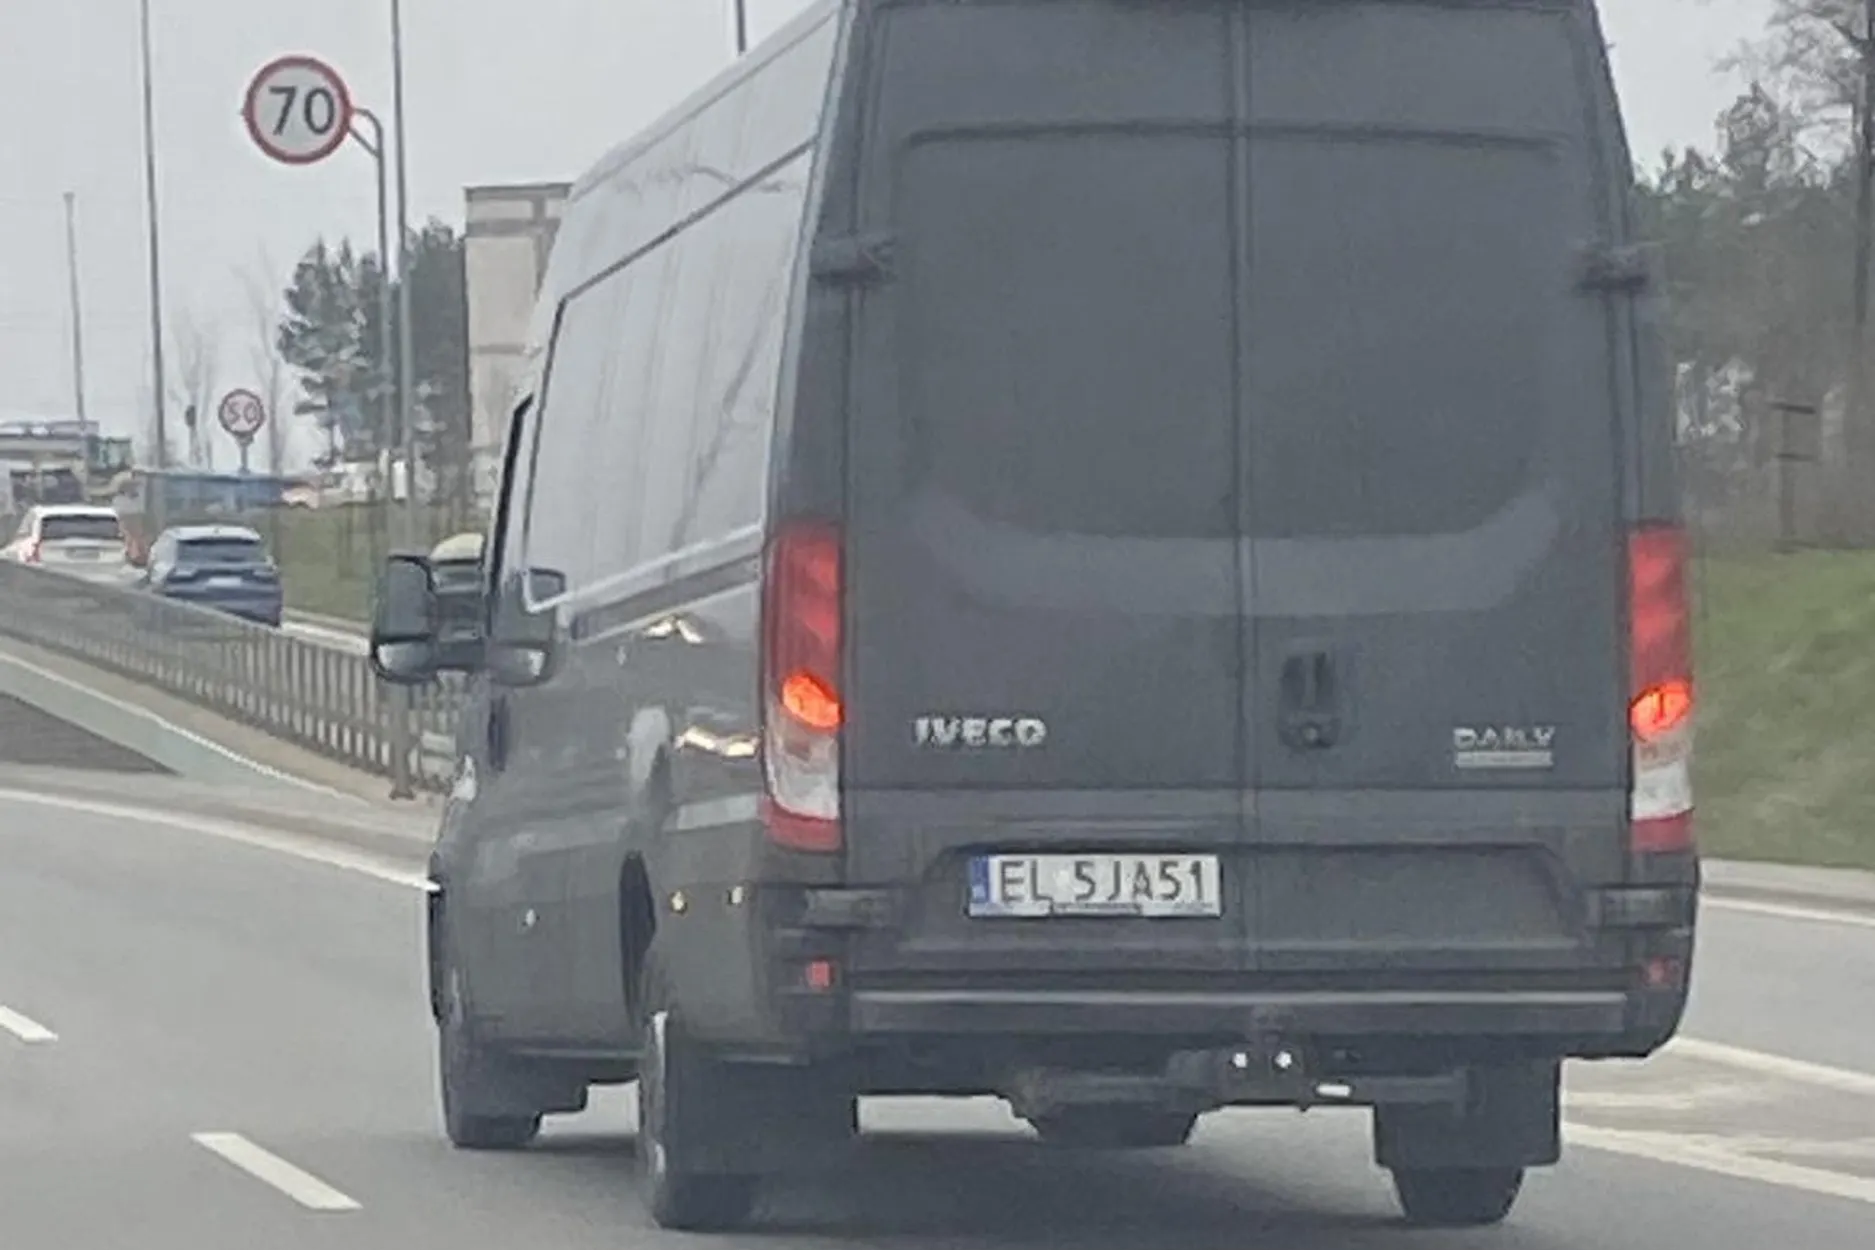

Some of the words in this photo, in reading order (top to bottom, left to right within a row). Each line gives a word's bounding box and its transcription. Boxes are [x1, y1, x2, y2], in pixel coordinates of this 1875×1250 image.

[269, 86, 335, 135] 70
[228, 401, 258, 425] 50
[913, 716, 1047, 747] IVECO
[1454, 727, 1555, 750] DAILY
[1001, 860, 1053, 902] EL
[1074, 860, 1204, 902] 5JA51
